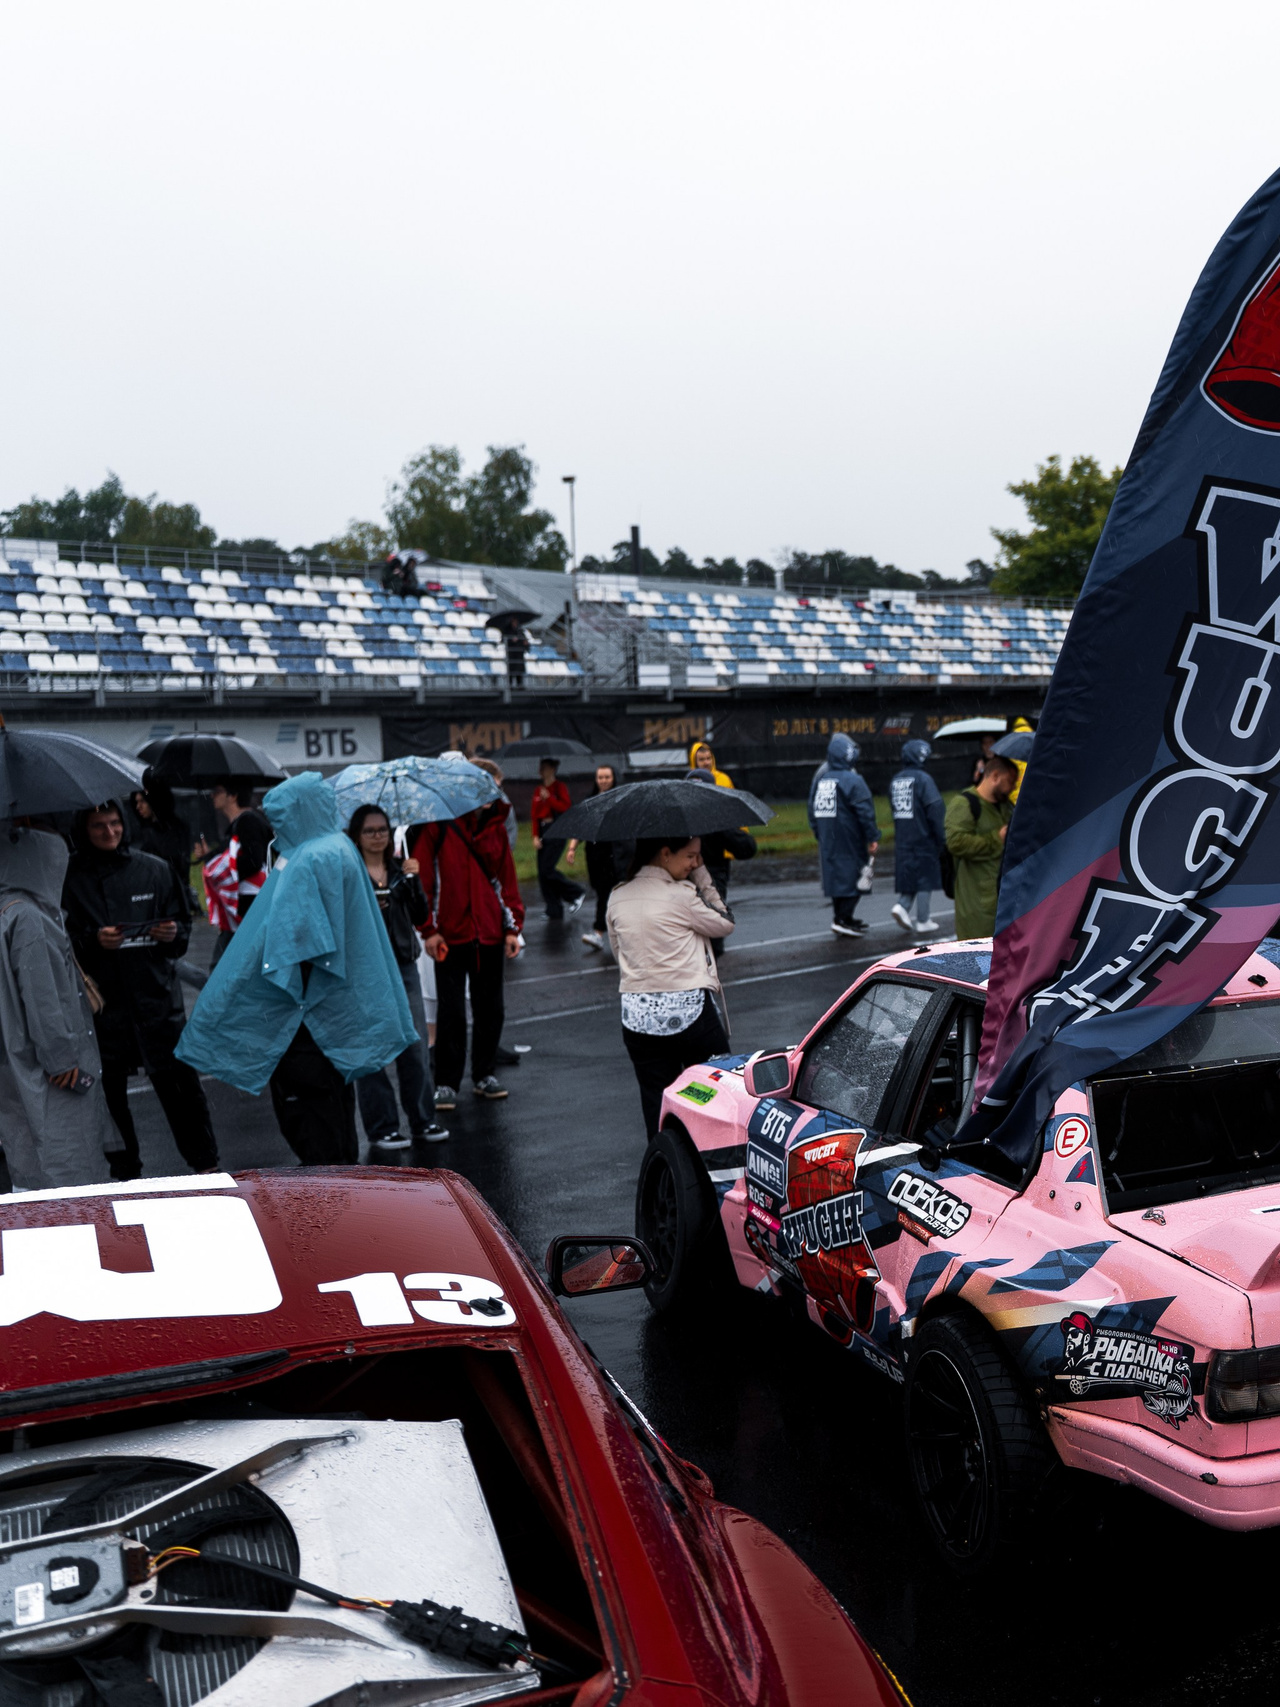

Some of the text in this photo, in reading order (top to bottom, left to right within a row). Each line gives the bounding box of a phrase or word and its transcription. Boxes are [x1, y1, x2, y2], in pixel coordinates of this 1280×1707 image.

[304, 728, 358, 758] ВТБ
[760, 1107, 792, 1144] ВТБ
[1062, 1127, 1078, 1149] E
[804, 1141, 840, 1164] WUCHT
[781, 1190, 864, 1259] WUCHT
[924, 1215, 955, 1237] CUSTOM
[317, 1272, 517, 1327] 13
[1096, 1328, 1158, 1345] РЫБОЛОВНЫЙ МАГАЗИН
[1092, 1337, 1174, 1374] РЫБАЛКА
[1104, 1363, 1169, 1387] ПАЛЫЧЕМ
